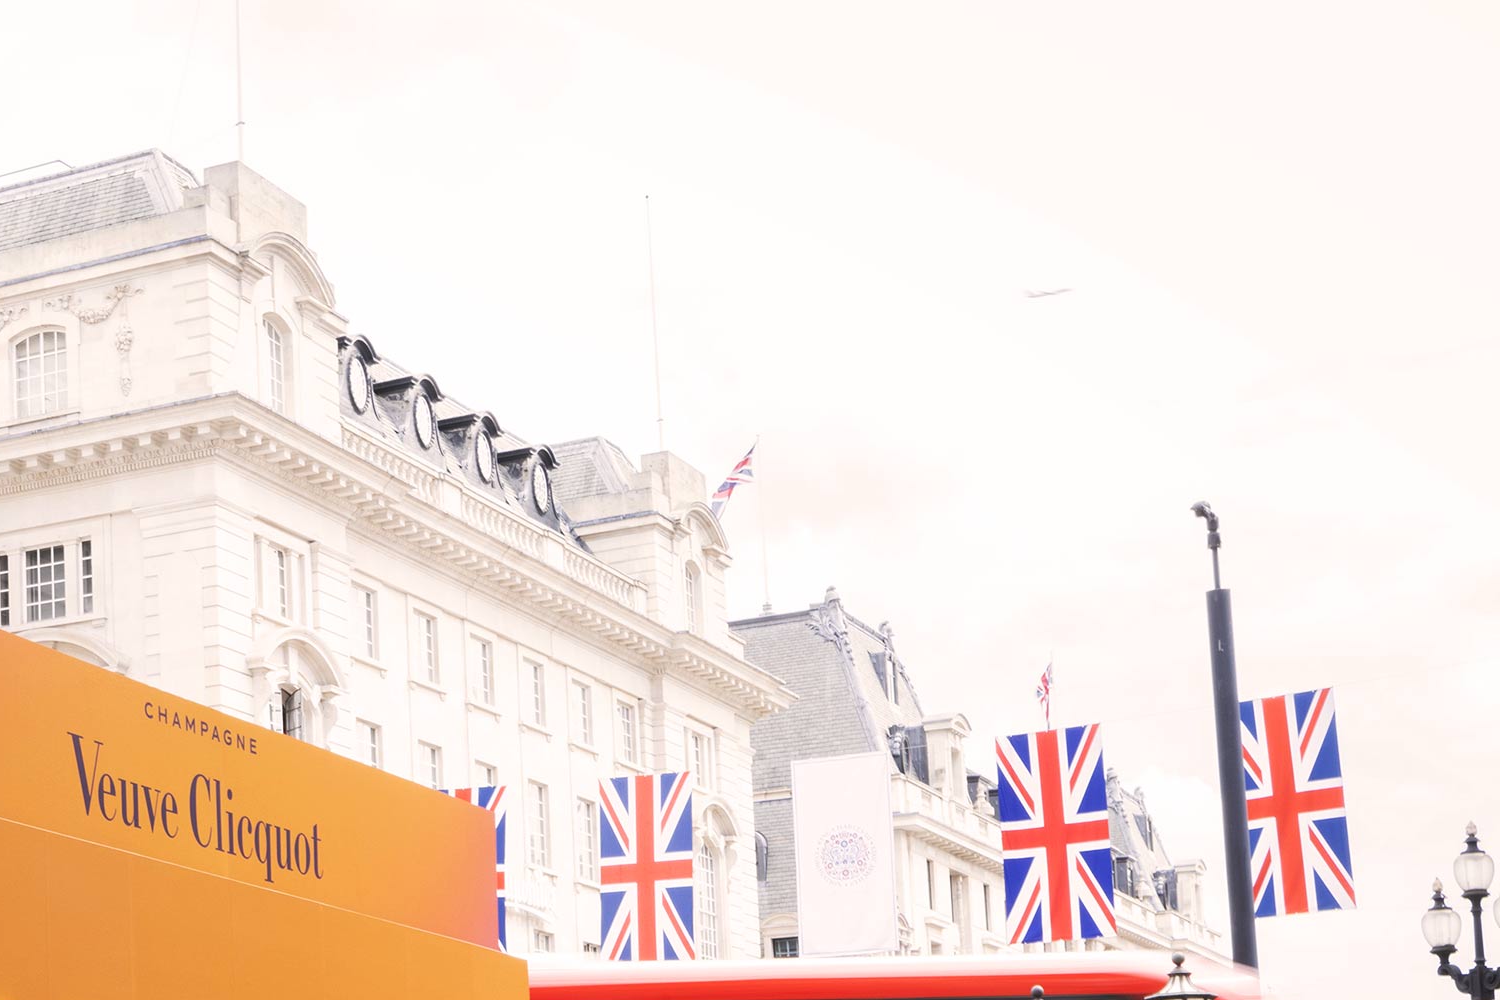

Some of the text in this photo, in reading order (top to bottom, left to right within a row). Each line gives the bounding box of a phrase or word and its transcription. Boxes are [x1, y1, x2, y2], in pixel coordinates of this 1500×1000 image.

[143, 702, 258, 754] CHAMPAGNE
[66, 731, 324, 883] Veuve Clicquot
